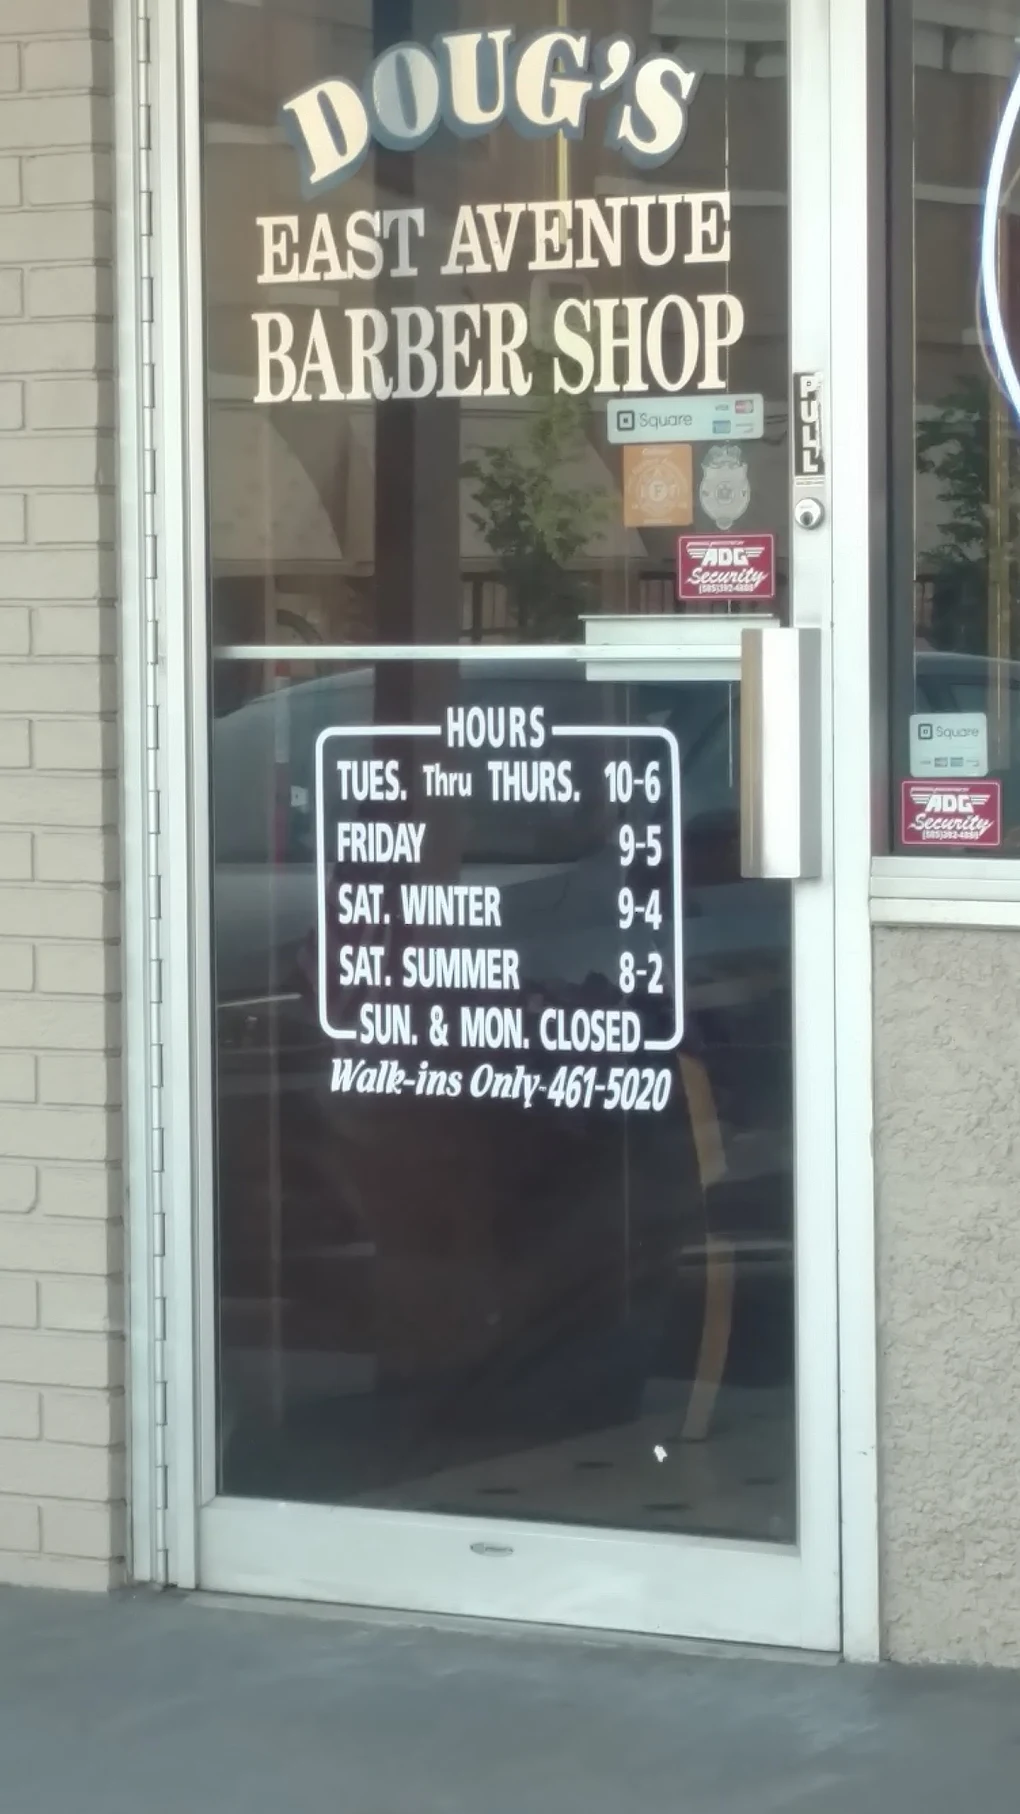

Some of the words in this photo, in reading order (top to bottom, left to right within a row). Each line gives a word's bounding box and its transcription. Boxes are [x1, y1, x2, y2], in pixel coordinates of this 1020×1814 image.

[281, 28, 697, 187] DOUG'S
[255, 207, 425, 283] EAST
[440, 191, 731, 275] AVENUE
[251, 302, 533, 403] BARBER
[552, 293, 745, 395] SHOP
[639, 411, 693, 429] Square
[799, 374, 823, 474] PULL
[685, 567, 769, 588] Security
[701, 547, 749, 567] ADG
[446, 706, 545, 748] HOURS
[935, 725, 980, 740] Square
[337, 760, 408, 801] TUES.
[422, 763, 472, 797] Thru
[488, 760, 580, 803] THURS.
[604, 760, 662, 804] 10-6
[924, 794, 975, 814] ADG
[336, 822, 427, 863] FRIDAY
[618, 824, 663, 867] 9-5
[907, 812, 995, 836] Security
[338, 884, 391, 925] SAT.
[399, 885, 502, 927] WINTER
[617, 886, 663, 930] 9-4
[338, 945, 392, 987] SAT.
[402, 947, 520, 990] SUMMER
[618, 952, 664, 994] 8-2
[359, 1002, 418, 1046] SUN.
[429, 1004, 449, 1047] &
[460, 1006, 530, 1050] MON.
[539, 1008, 642, 1052] CLOSED
[330, 1057, 463, 1098] Walk-ins
